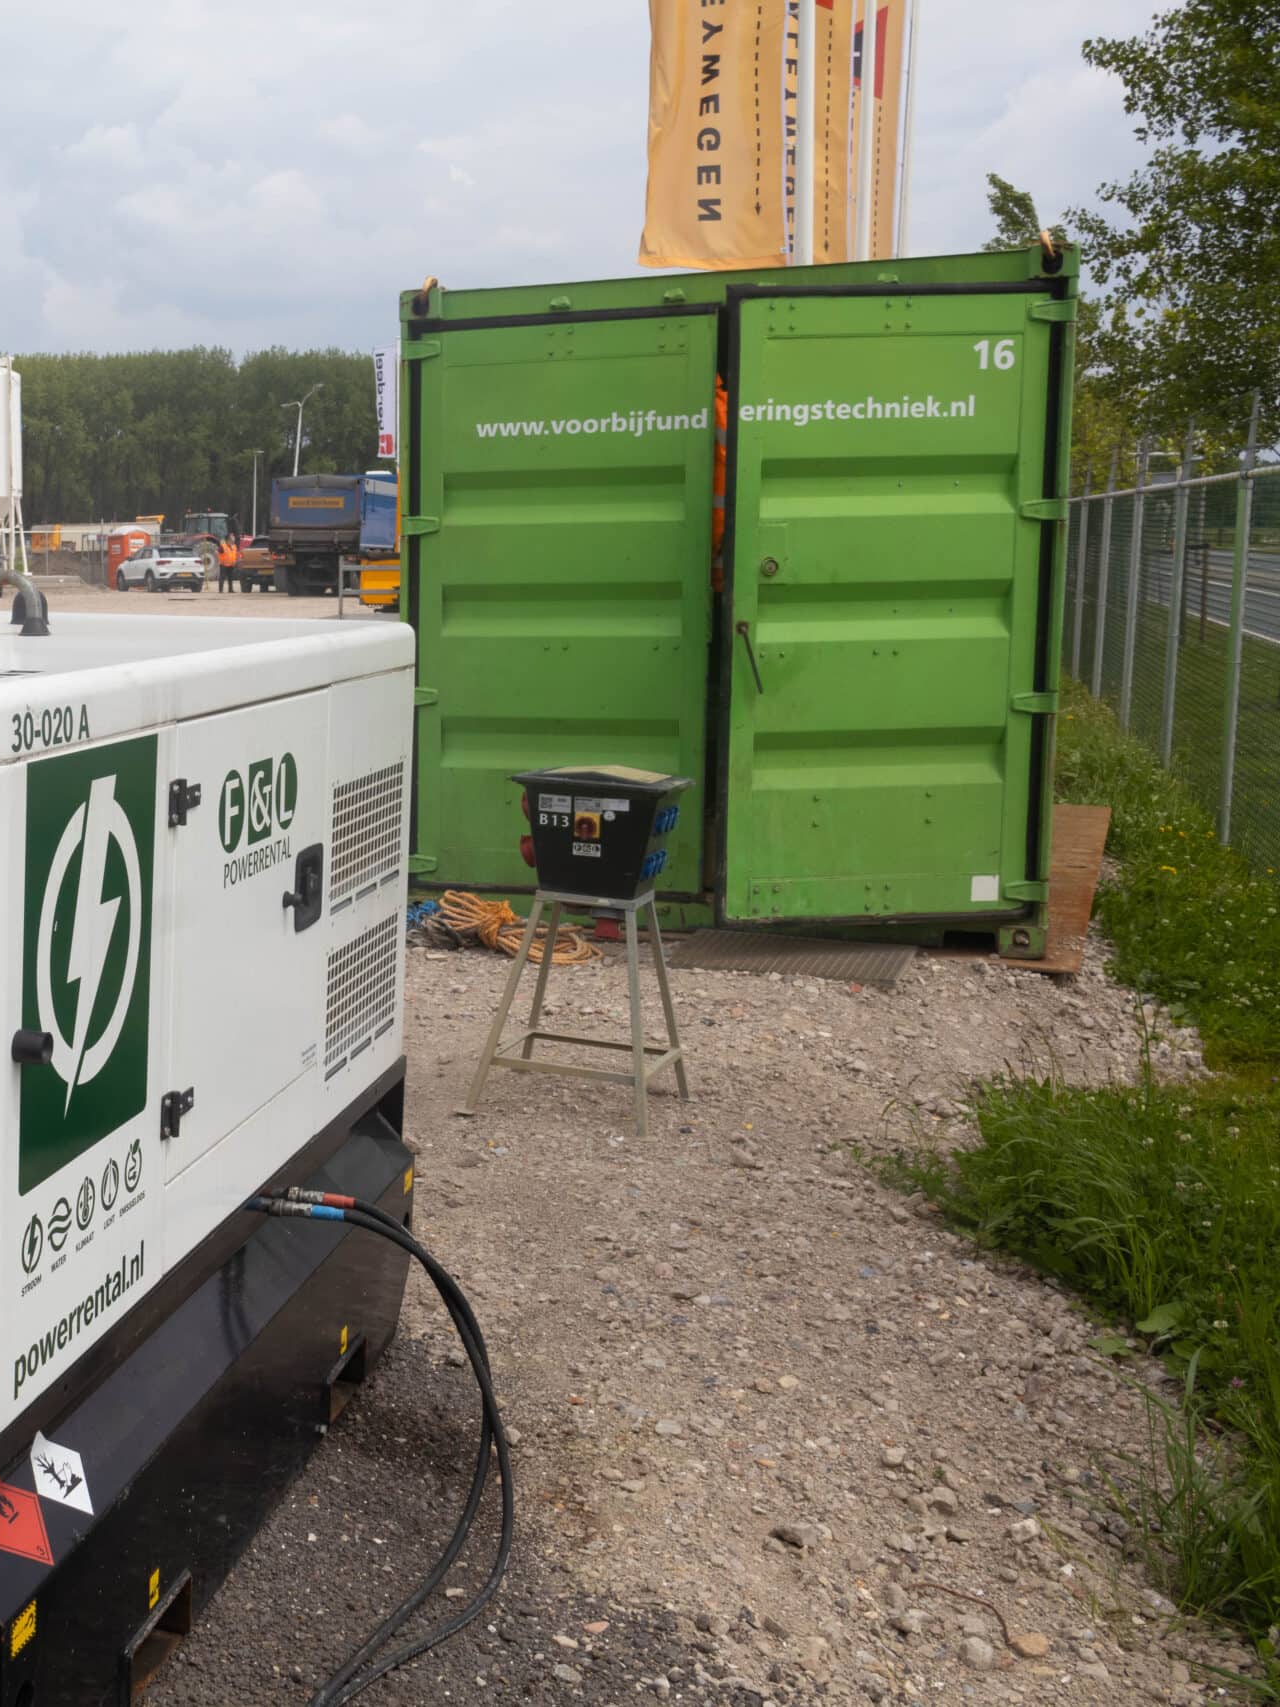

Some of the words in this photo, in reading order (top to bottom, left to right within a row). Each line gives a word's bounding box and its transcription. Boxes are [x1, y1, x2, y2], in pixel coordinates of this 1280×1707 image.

[973, 338, 1016, 370] 16
[476, 408, 708, 438] www.voorbijfund
[739, 395, 976, 427] eringstechniek.nl
[12, 707, 73, 753] 30-020
[77, 704, 90, 740] A
[223, 836, 292, 889] POWERRENTAL
[51, 1253, 67, 1273] WATER
[21, 1273, 42, 1297] STROOM
[14, 1239, 145, 1400] powerrental.nl
